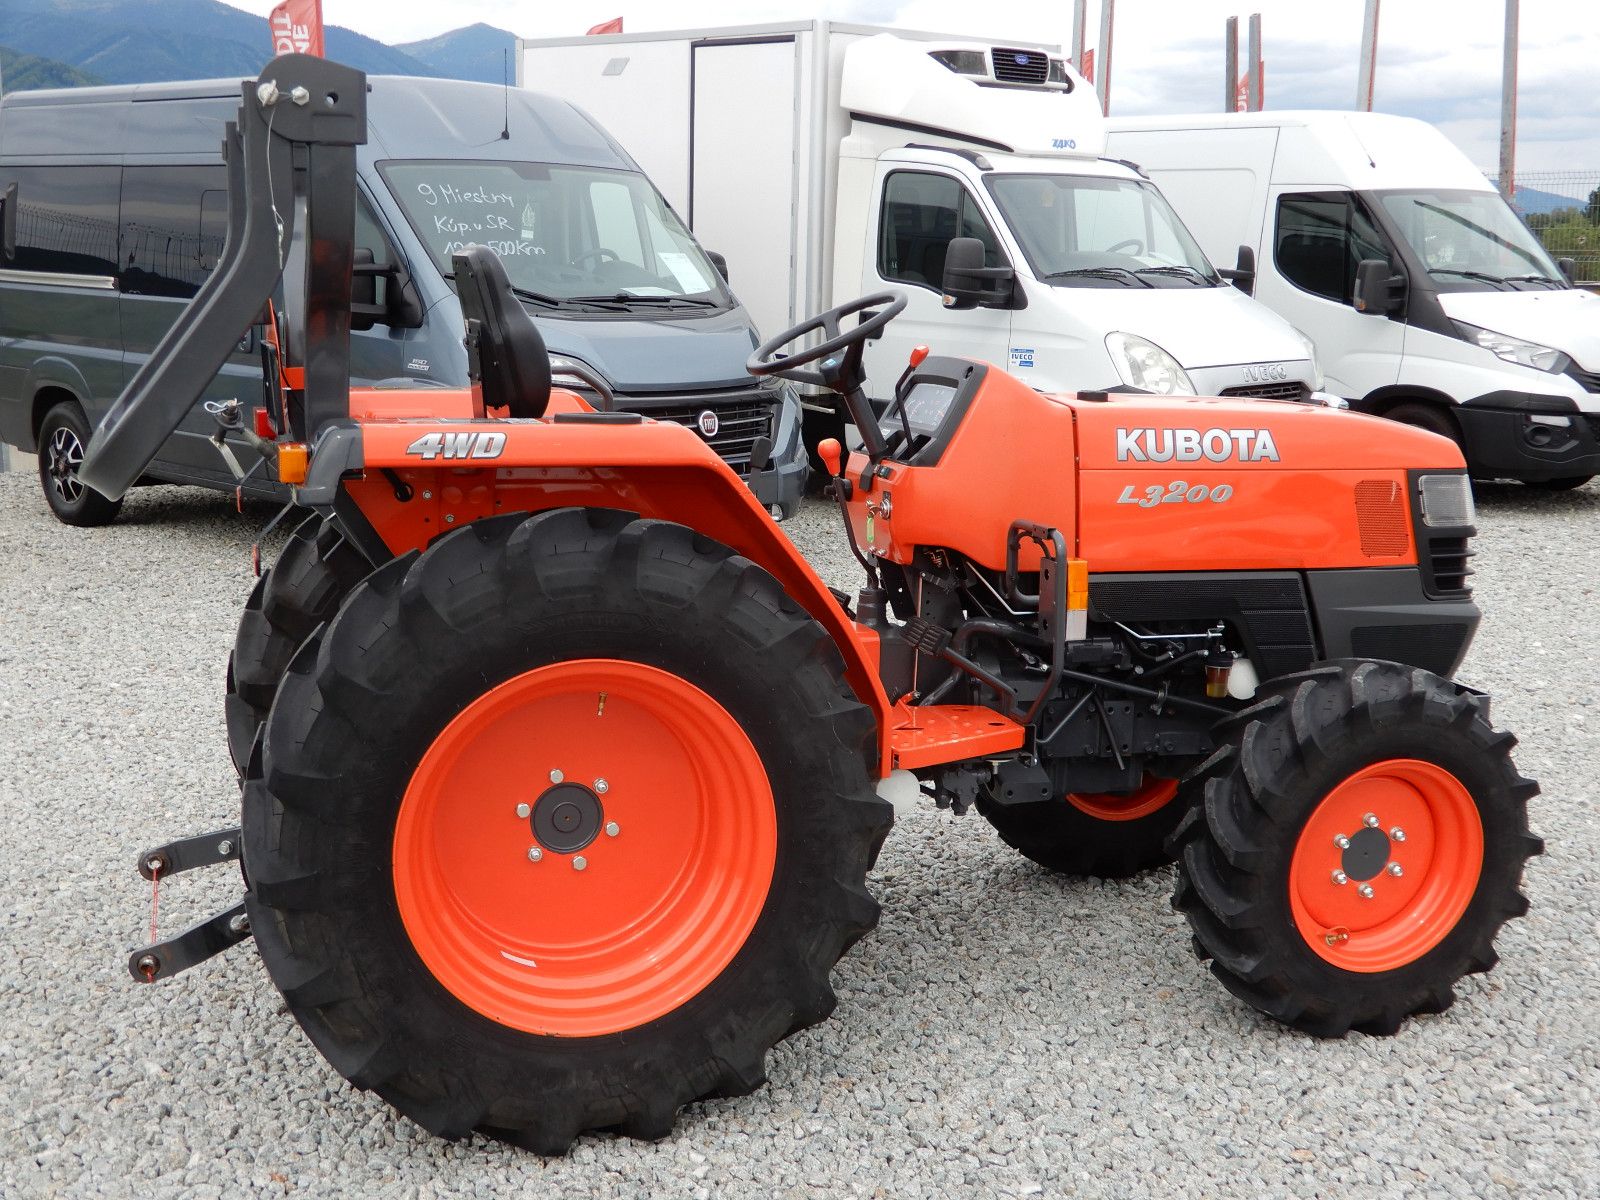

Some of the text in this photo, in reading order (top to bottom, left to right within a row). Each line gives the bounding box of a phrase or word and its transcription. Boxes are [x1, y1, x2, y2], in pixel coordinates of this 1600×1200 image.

[417, 183, 515, 208] 9 Miestny
[486, 214, 515, 231] SR
[1011, 353, 1033, 361] IVECO
[1242, 364, 1287, 383] IVECO
[406, 431, 507, 460] 4WD
[1116, 427, 1280, 463] KUBOTA
[1116, 480, 1234, 508] L3200
